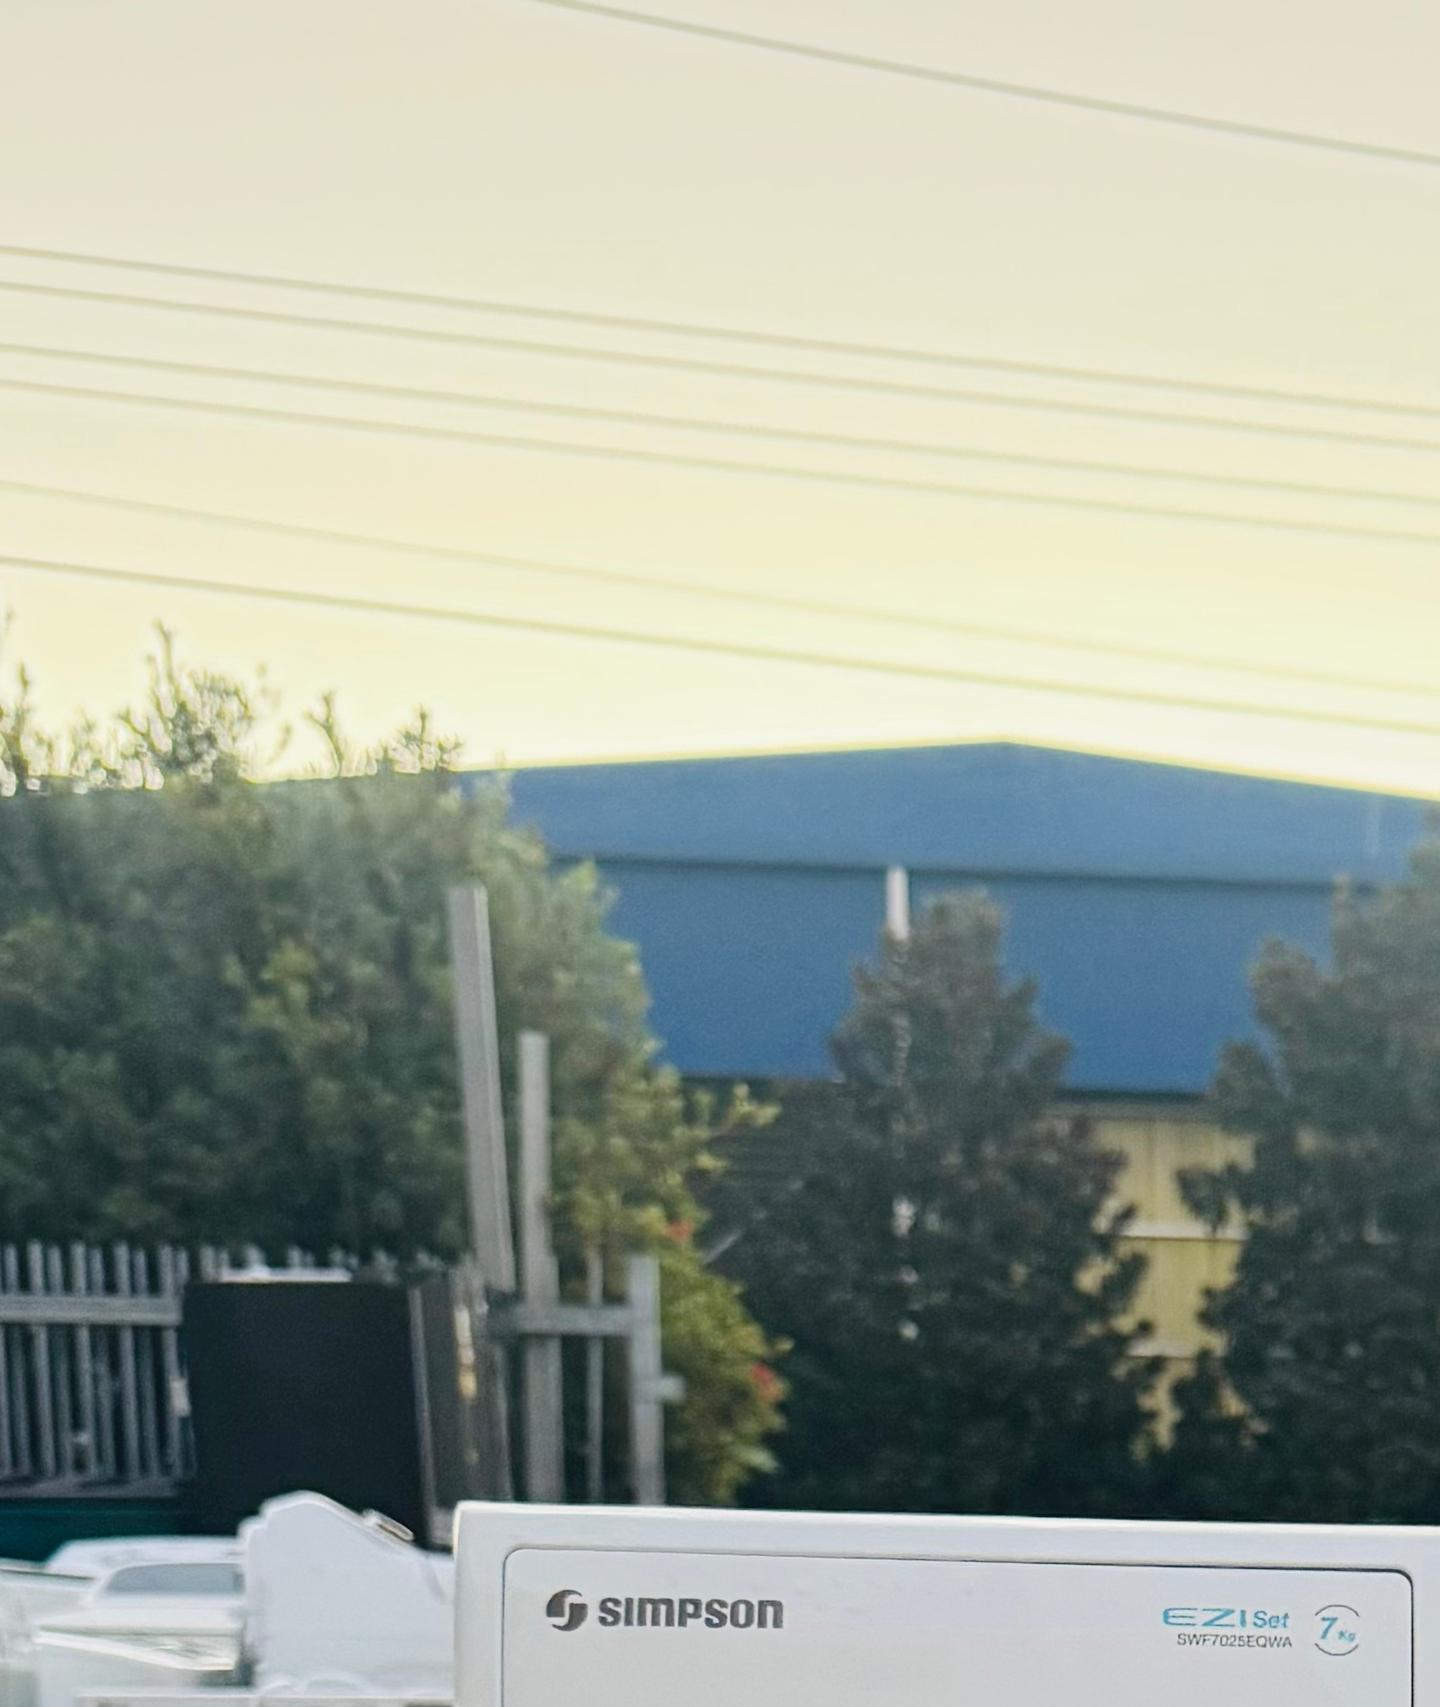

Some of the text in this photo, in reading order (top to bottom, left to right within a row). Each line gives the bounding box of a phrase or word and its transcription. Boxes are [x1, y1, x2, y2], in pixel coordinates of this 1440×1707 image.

[598, 1596, 783, 1630] SIMPSON
[1163, 1608, 1289, 1628] EZI Set
[1177, 1634, 1292, 1648] SWF7025EQWA
